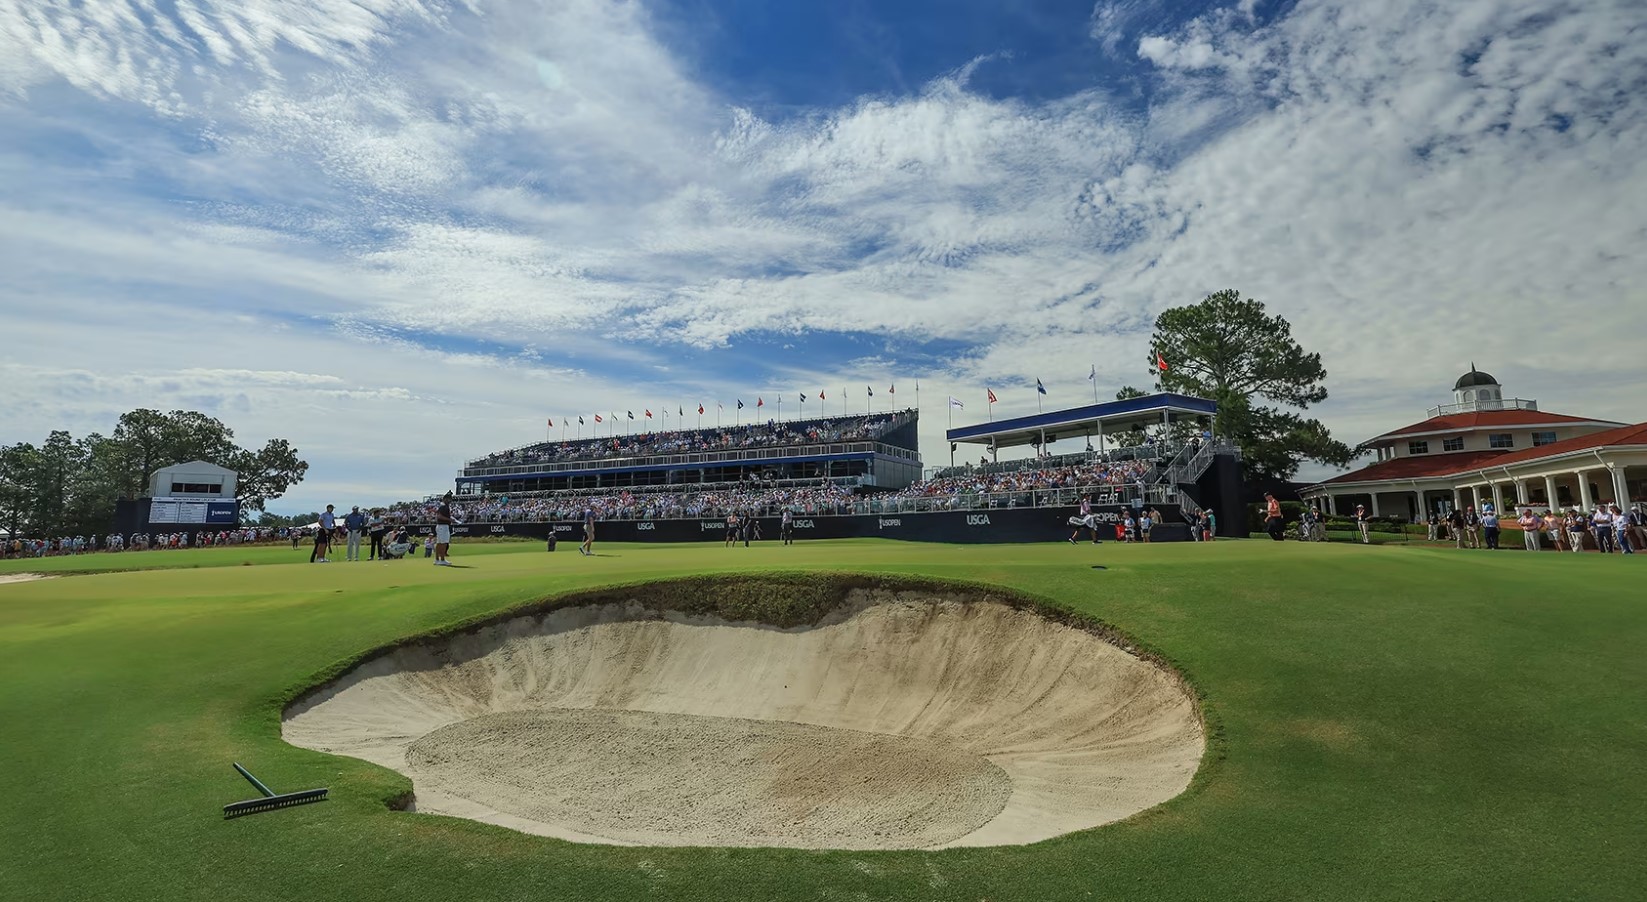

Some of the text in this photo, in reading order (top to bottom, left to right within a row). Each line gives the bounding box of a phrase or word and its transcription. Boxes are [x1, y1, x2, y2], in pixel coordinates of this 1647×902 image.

[793, 519, 815, 528] USGA
[967, 514, 990, 525] USGA
[491, 525, 505, 533] USGA
[637, 522, 655, 530] USGA
